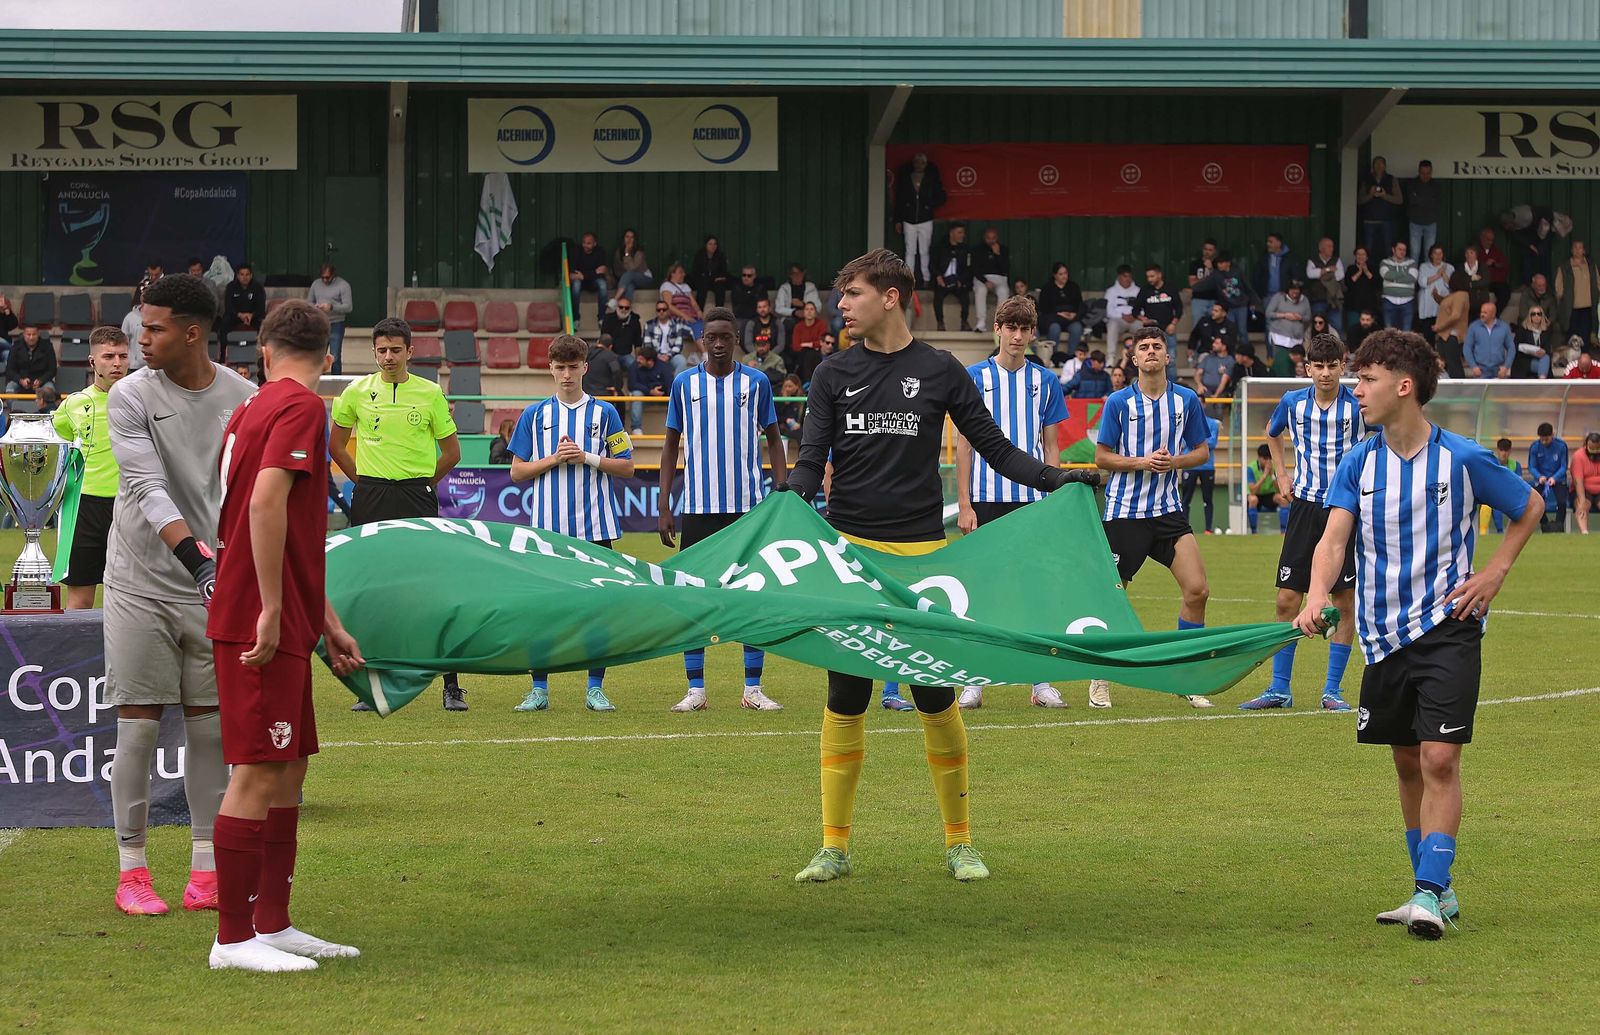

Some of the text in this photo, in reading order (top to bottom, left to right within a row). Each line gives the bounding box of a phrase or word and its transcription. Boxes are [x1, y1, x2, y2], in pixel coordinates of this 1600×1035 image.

[35, 101, 242, 150] RSG
[497, 129, 545, 142] ACERINOX
[593, 129, 641, 142] ACERINOX
[693, 128, 740, 141] ACERINOX
[1476, 111, 1600, 159] RS
[867, 411, 921, 423] DIPUTACIÓN
[867, 420, 919, 430] DE HUELVA
[610, 437, 625, 449] ELVA
[448, 476, 486, 485] ANDALUCÍA
[8, 664, 117, 724] Cop
